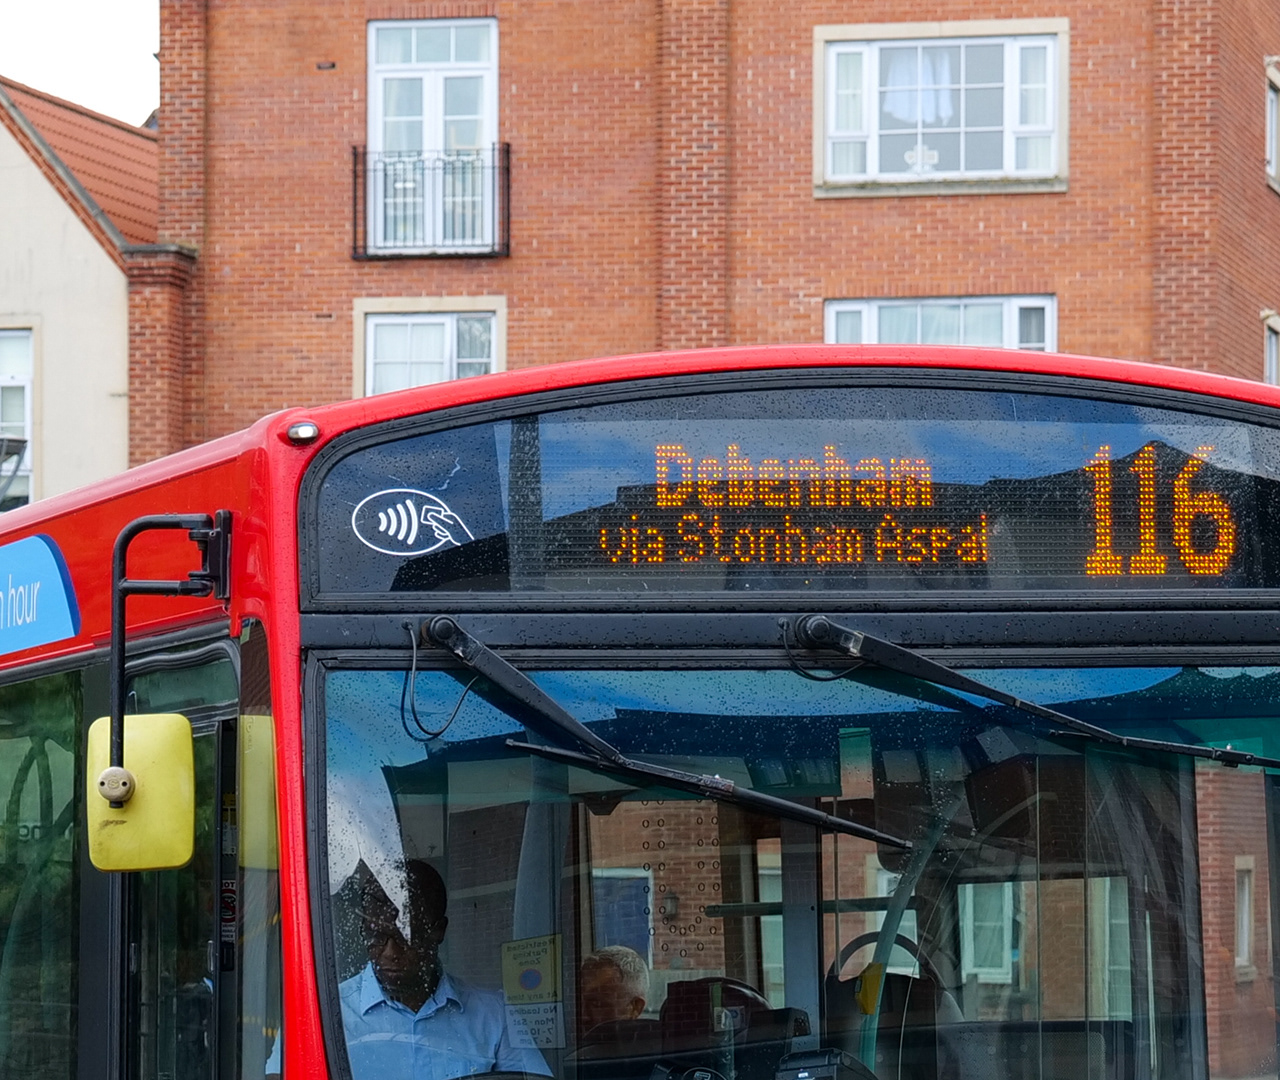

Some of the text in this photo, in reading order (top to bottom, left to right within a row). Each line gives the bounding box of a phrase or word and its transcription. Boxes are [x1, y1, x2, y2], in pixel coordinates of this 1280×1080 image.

[655, 444, 933, 507] Debenham
[599, 513, 665, 563] via
[676, 512, 865, 563] Stonham
[1083, 444, 1236, 576] 116
[7, 573, 41, 628] hour
